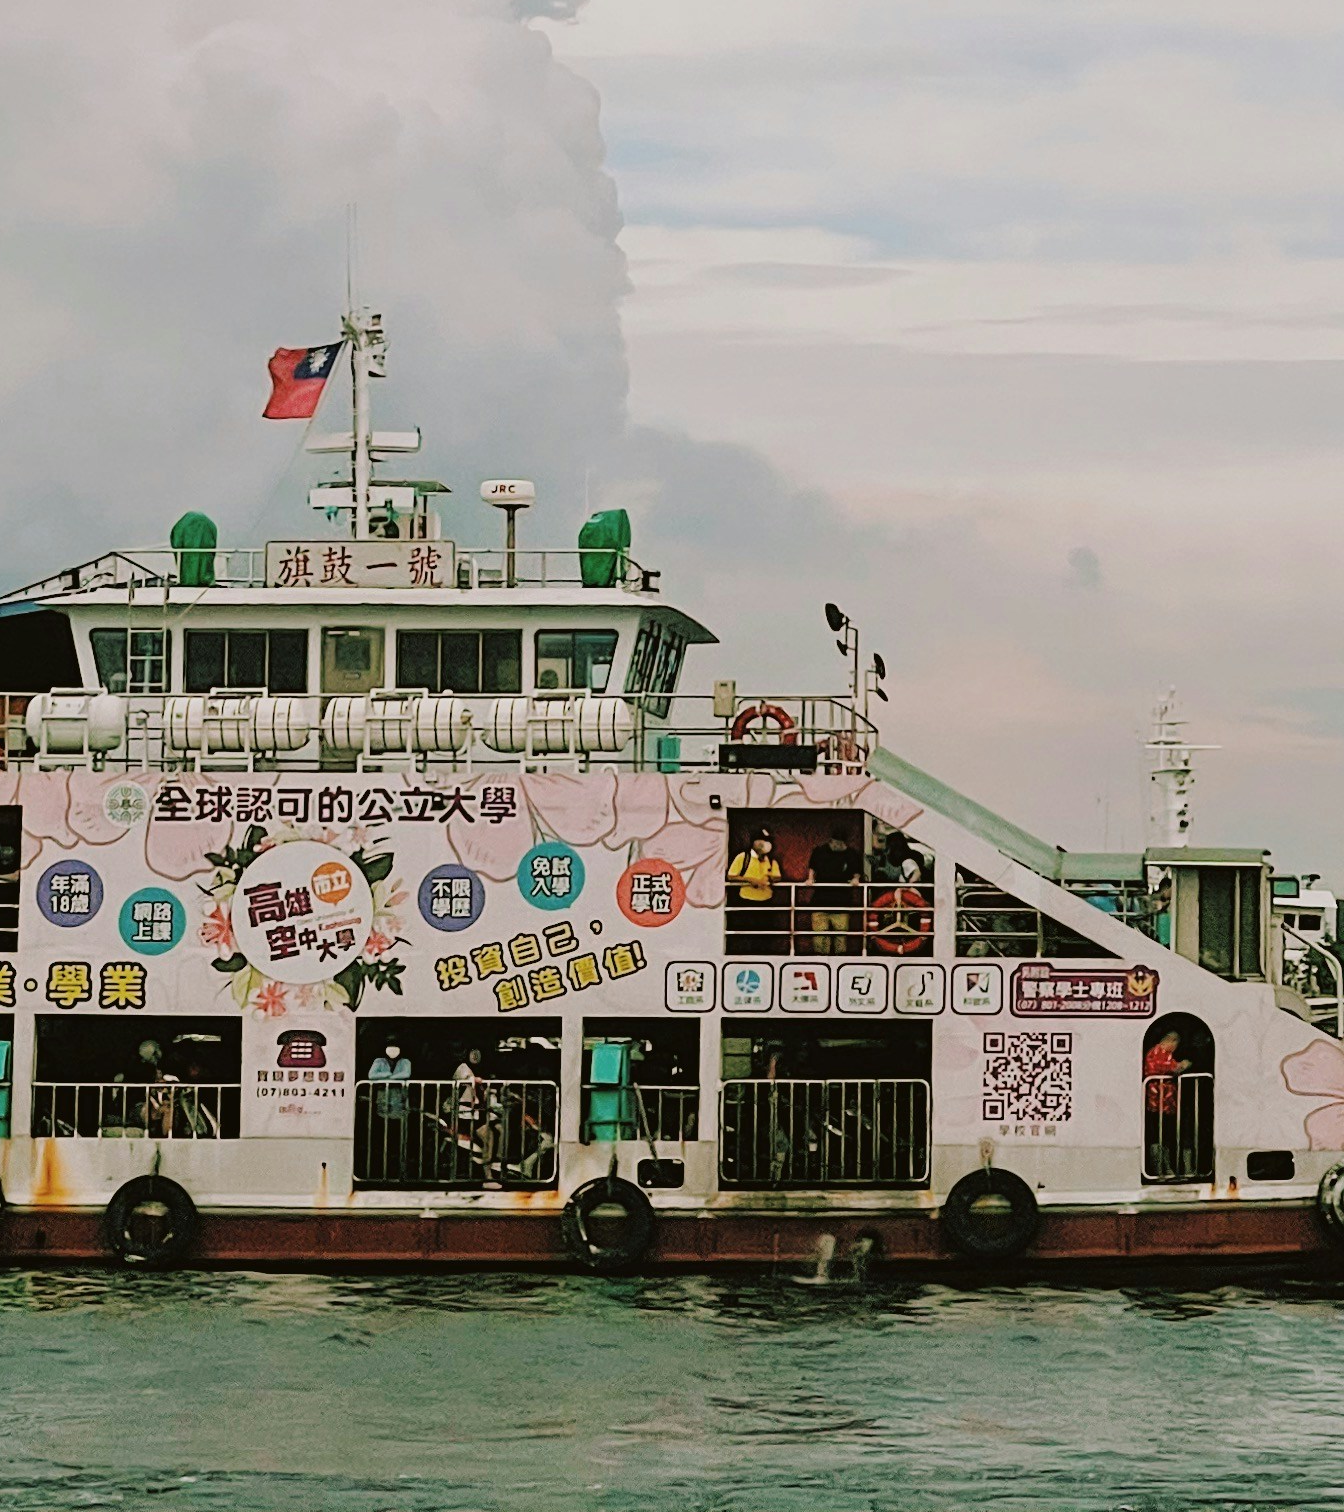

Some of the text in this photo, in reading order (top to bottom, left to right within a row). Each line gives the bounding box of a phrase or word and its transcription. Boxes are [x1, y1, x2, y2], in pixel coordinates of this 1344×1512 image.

[491, 484, 516, 494] JRC
[279, 545, 443, 588] 旗鼓一號
[154, 785, 518, 824] 全球認可的公立大學
[531, 855, 572, 876] 免試
[50, 873, 90, 894] 年滿
[312, 869, 351, 896] 市立
[431, 877, 472, 898] 不限
[531, 876, 572, 898] 入學
[631, 873, 672, 893] 正式
[50, 894, 90, 915] 18歲
[132, 901, 174, 922] 網路
[243, 881, 313, 928] 高雄
[431, 898, 472, 919] 學歷
[631, 893, 672, 914] 學位
[132, 922, 174, 942] 上課
[265, 925, 356, 963] 空中大學
